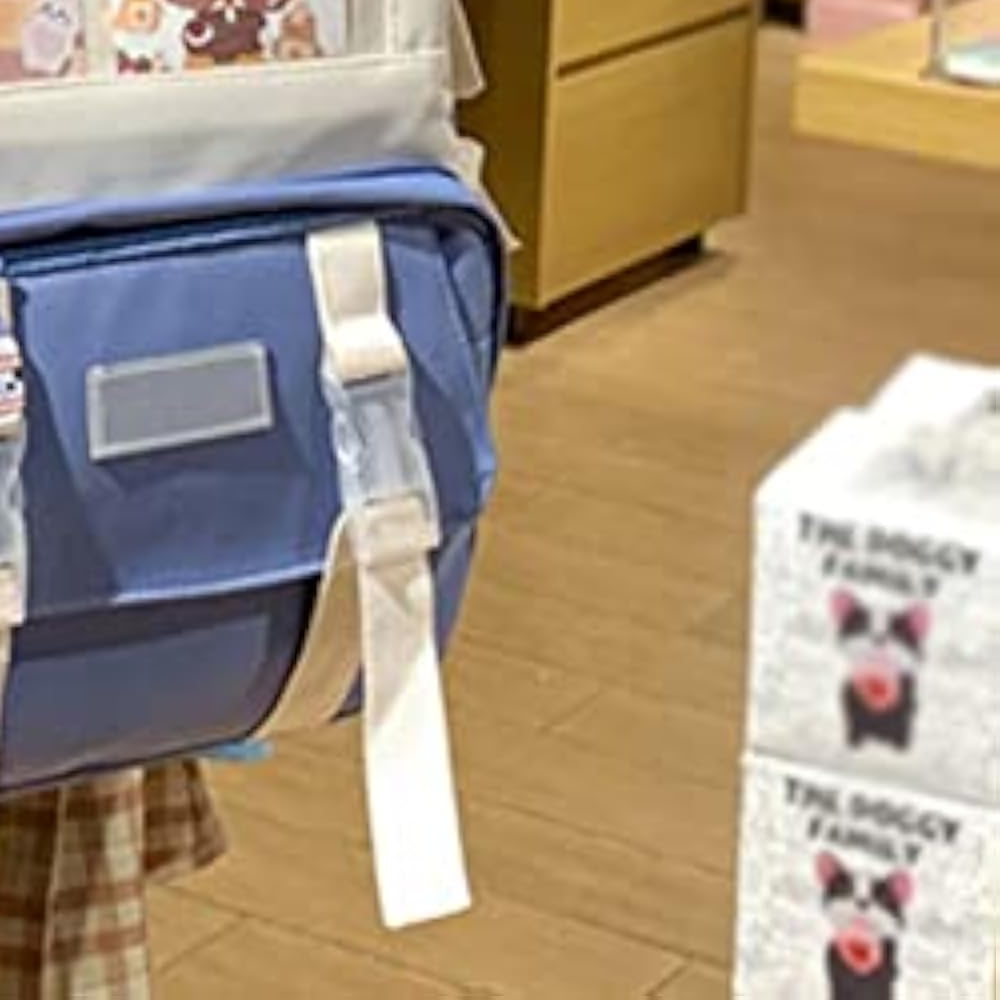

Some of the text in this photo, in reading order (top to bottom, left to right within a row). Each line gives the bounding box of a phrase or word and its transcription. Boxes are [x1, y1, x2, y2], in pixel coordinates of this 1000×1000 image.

[798, 511, 981, 575] THE DOGGY
[822, 552, 939, 598] FAMILY
[784, 775, 960, 844] THE DOGGY
[806, 815, 922, 865] FAMILY
